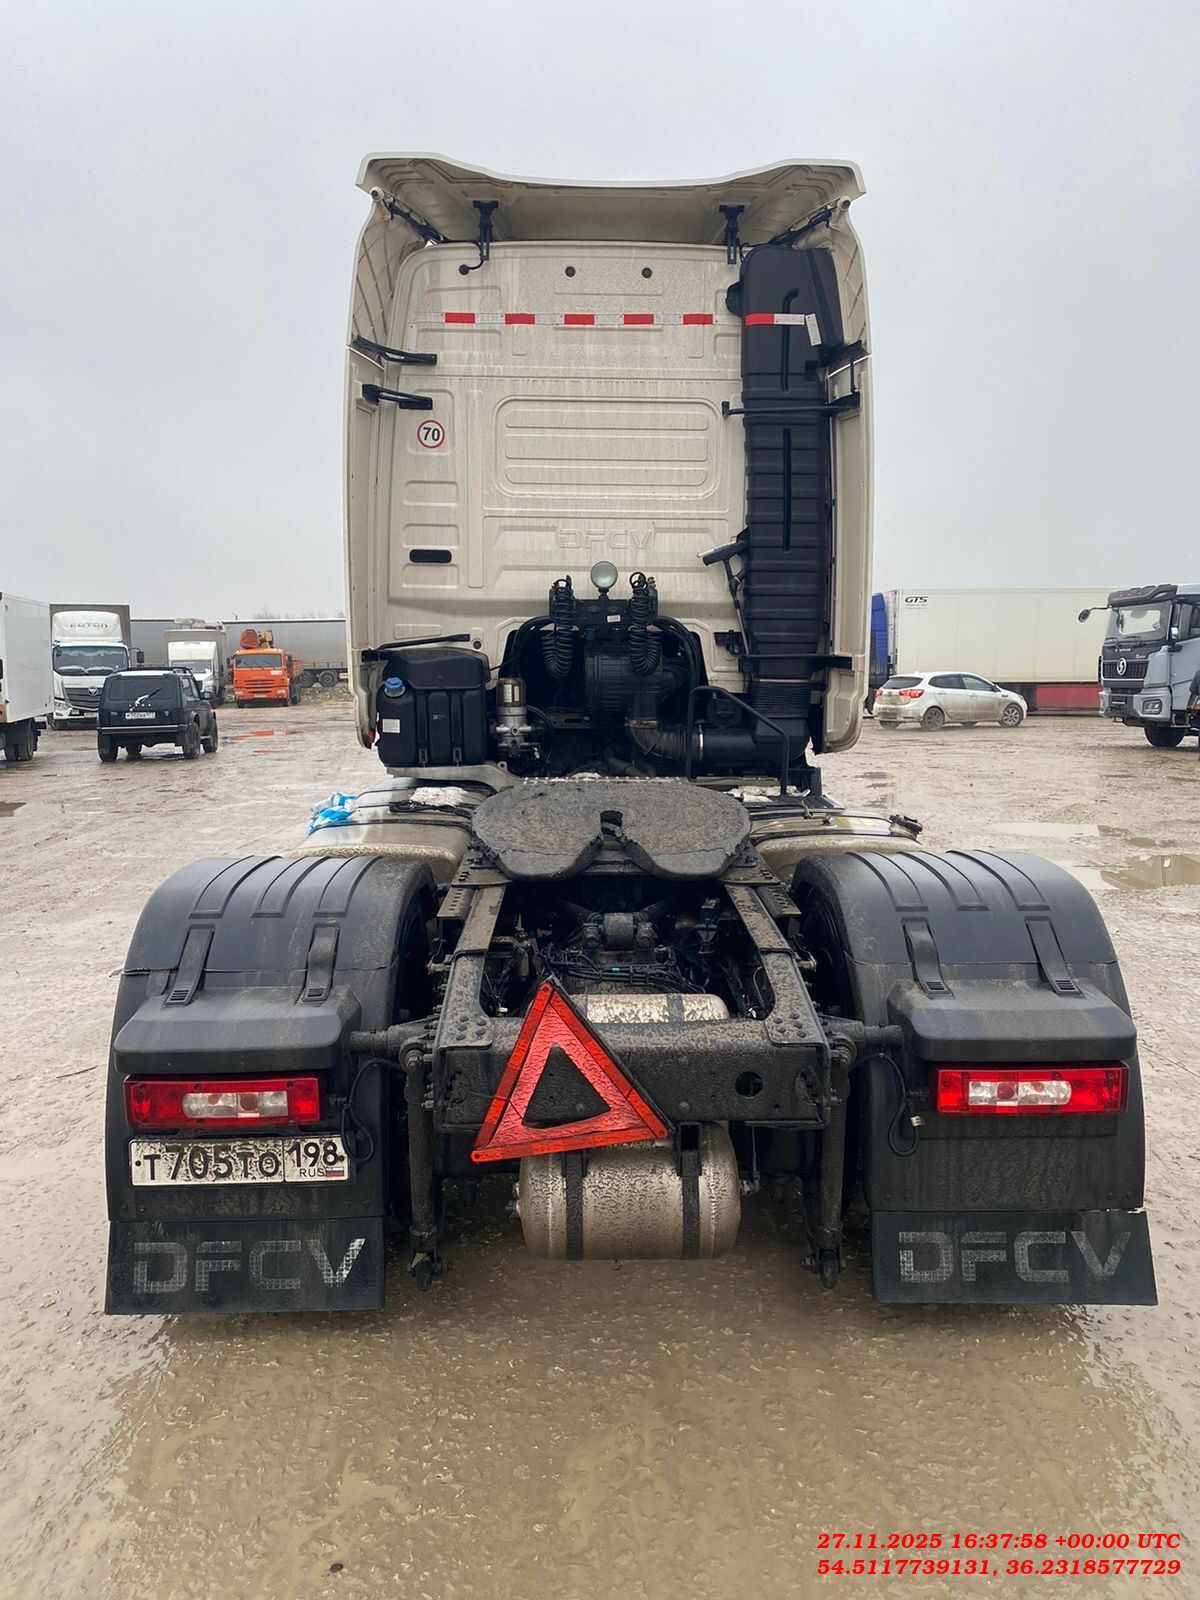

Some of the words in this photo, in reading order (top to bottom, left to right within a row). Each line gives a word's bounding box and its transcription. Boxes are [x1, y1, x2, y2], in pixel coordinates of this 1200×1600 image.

[422, 427, 441, 442] 70
[286, 1140, 338, 1168] 198
[300, 1167, 325, 1178] RUS
[132, 1238, 367, 1294] DFCV
[899, 1231, 1132, 1283] DFCV
